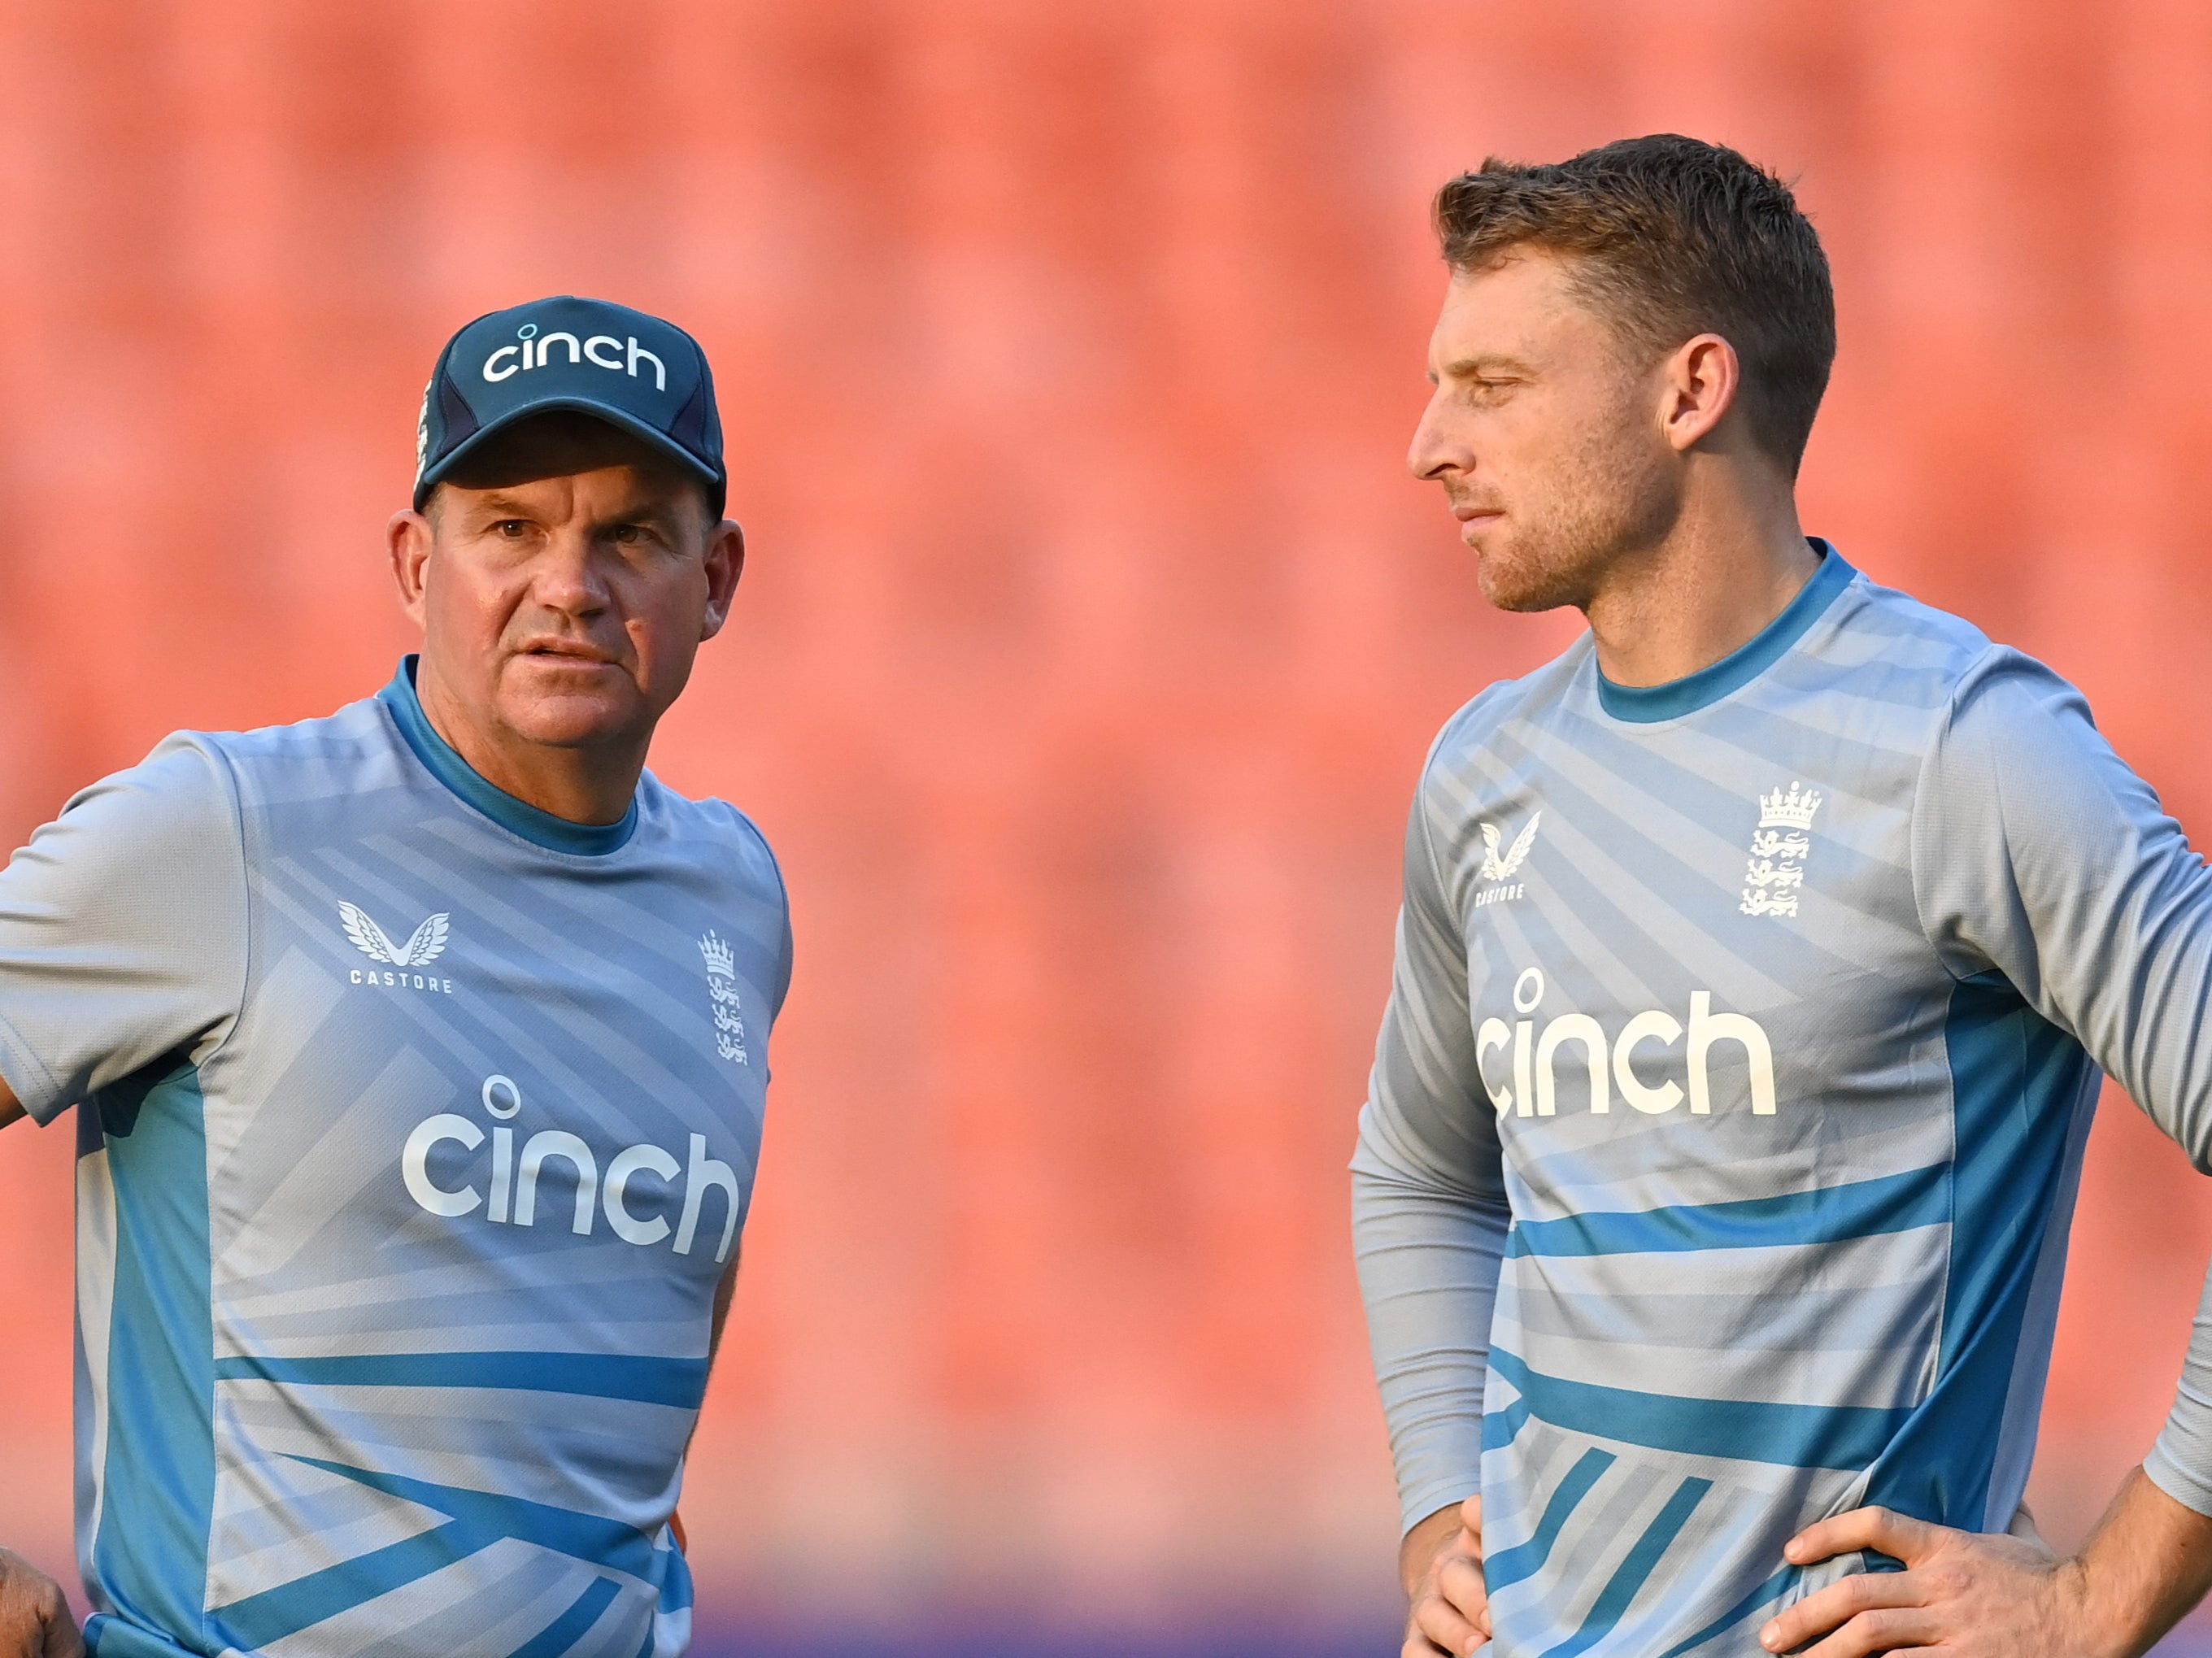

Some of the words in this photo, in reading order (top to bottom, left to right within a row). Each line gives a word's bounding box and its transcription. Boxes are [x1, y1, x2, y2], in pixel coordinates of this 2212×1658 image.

[483, 324, 666, 391] cinch
[350, 969, 452, 994] CASTORE
[1476, 967, 1776, 1121] cinch
[402, 1074, 739, 1263] cinch
